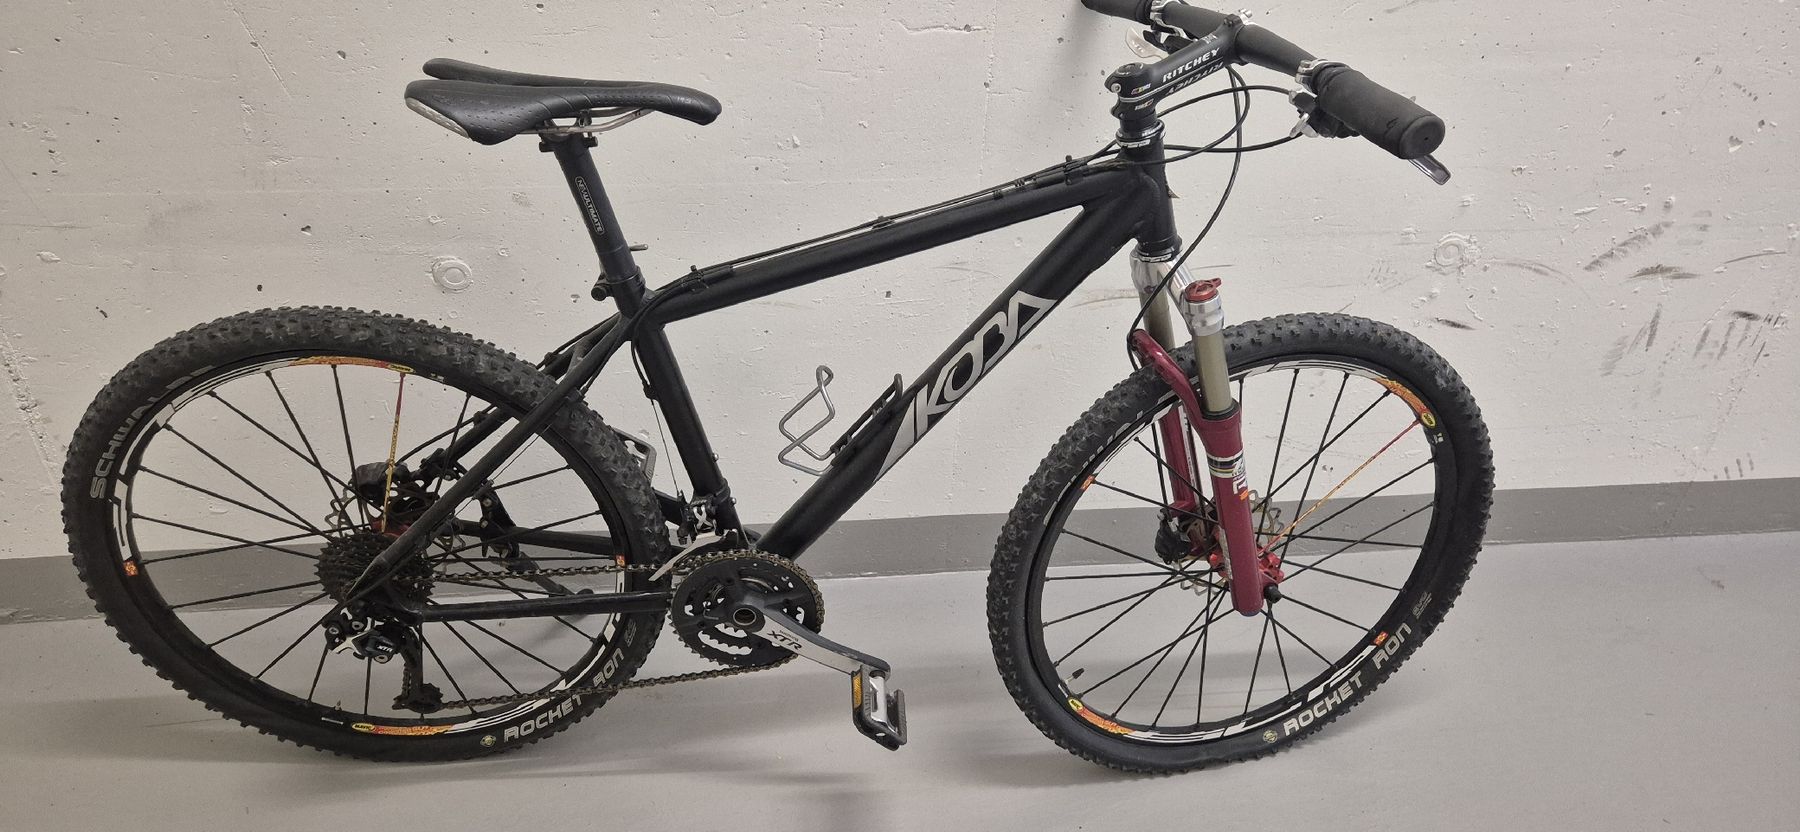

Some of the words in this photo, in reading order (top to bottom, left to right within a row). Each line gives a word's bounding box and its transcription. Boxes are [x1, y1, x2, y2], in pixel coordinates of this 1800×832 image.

[1163, 48, 1220, 82] RITCHEY
[1165, 61, 1223, 96] RITCHEY
[917, 290, 1058, 441] KOBA
[767, 630, 802, 650] XTR
[504, 694, 582, 743] ROCKET
[593, 647, 625, 688] RON
[1283, 671, 1363, 737] ROCKET
[1372, 622, 1412, 670] RON
